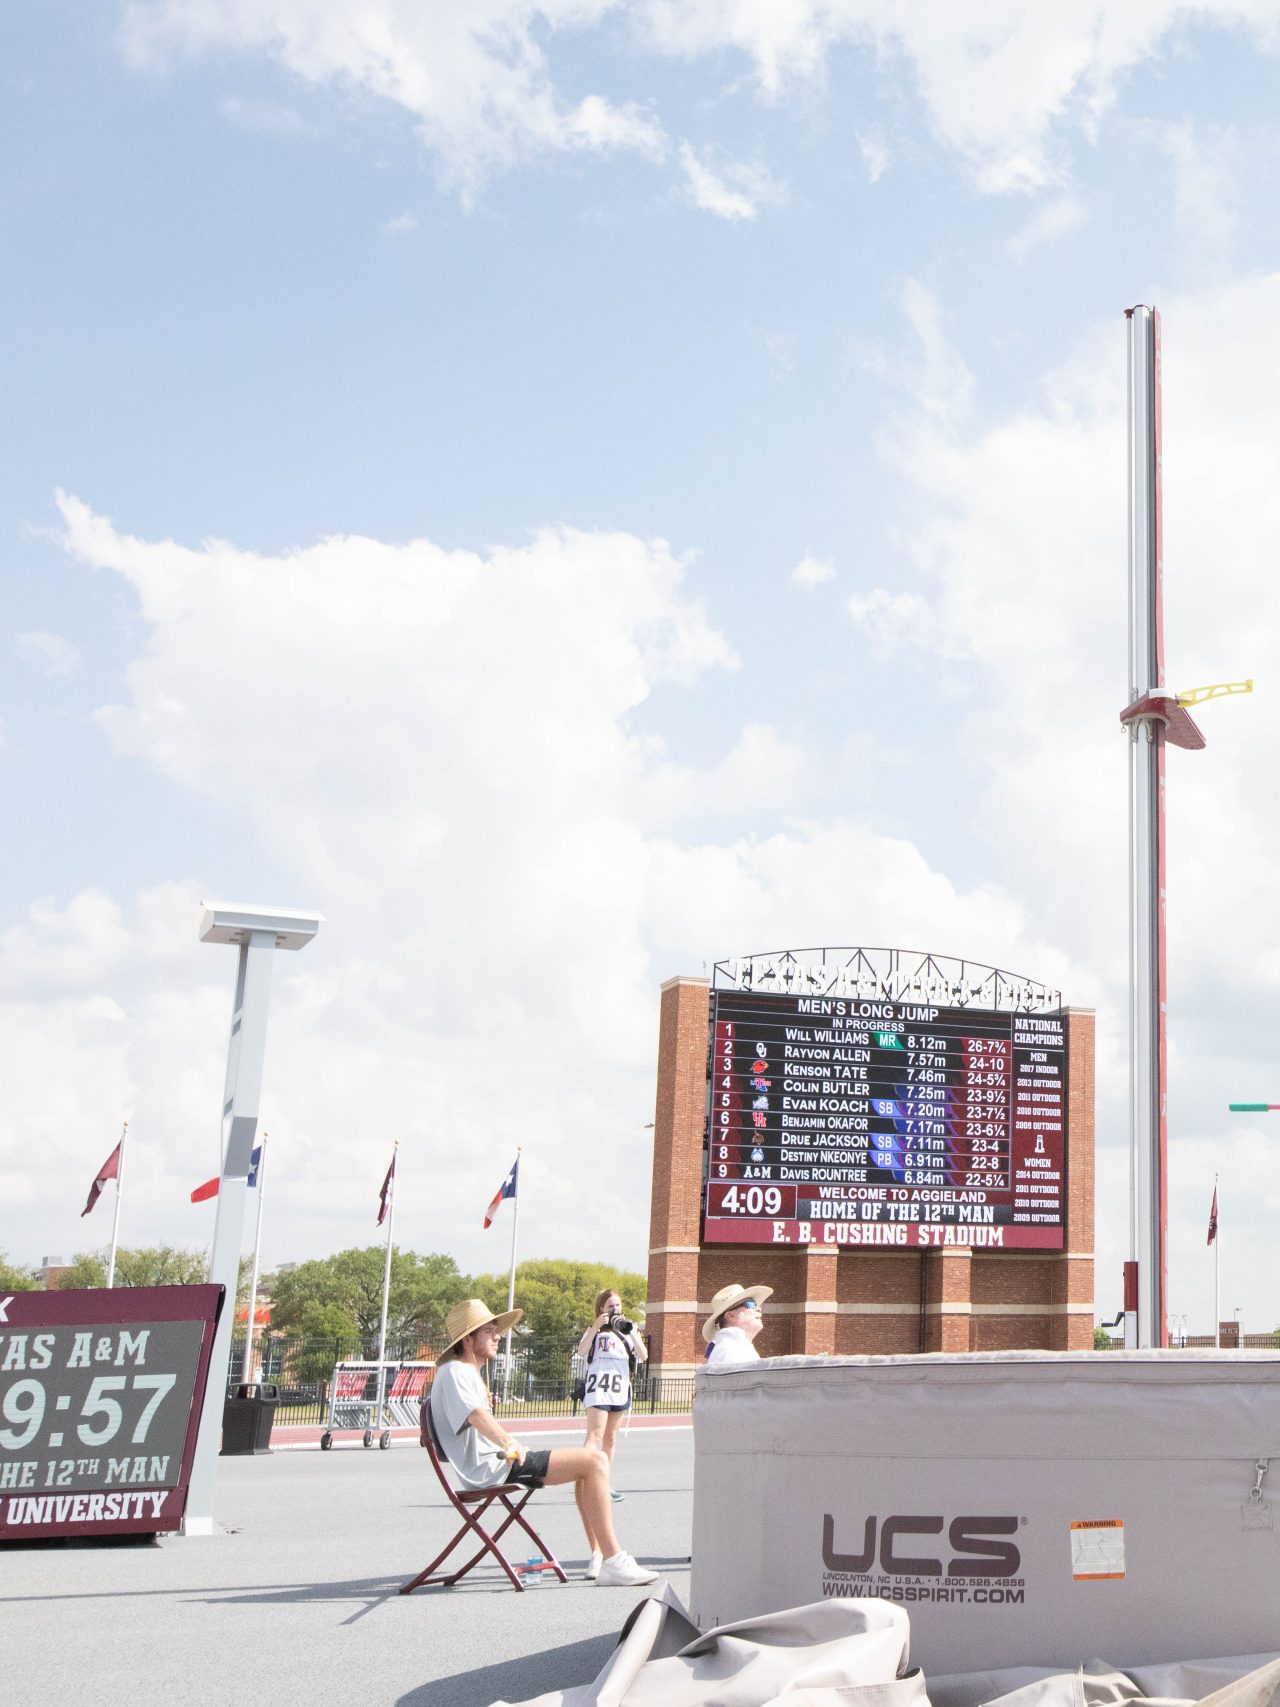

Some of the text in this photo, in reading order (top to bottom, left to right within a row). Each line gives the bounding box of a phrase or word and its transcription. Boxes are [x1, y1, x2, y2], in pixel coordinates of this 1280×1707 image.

[729, 957, 827, 994] TEXAS
[798, 999, 938, 1021] MEN'S LONG JUMP
[832, 1019, 904, 1032] IN PROGRESS
[1015, 1019, 1063, 1032] NATIONAL
[726, 1024, 732, 1036] 1
[786, 1028, 811, 1041] WILL
[814, 1030, 869, 1045] WILLIAMS
[879, 1033, 896, 1047] MR
[908, 1036, 946, 1050] 8.12m
[1015, 1033, 1063, 1045] CHAMPIONS
[724, 1042, 732, 1054] 2
[784, 1046, 830, 1059] RAYVON
[833, 1048, 870, 1062] ALLEN
[908, 1053, 946, 1066] 7.57m
[970, 1057, 1004, 1070] 24-10
[1031, 1053, 1047, 1062] MEN
[723, 1058, 732, 1071] 3
[784, 1064, 830, 1077] KENSON
[834, 1066, 867, 1079] TATE
[907, 1069, 945, 1082] 7.46m
[1036, 1066, 1058, 1074] INDOOR
[723, 1076, 730, 1088] 4
[783, 1080, 820, 1093] COLIN
[823, 1082, 869, 1095] BUTLER
[907, 1086, 945, 1099] 7.25m
[1017, 1078, 1061, 1088] 2013 OUTDOOR
[722, 1094, 730, 1106] 5
[783, 1097, 817, 1110] EVAN
[820, 1099, 868, 1112] KOACH
[879, 1102, 893, 1114] SB
[907, 1103, 944, 1117] 7.20m
[1018, 1093, 1060, 1102] 2011 OUTDOOR
[1017, 1107, 1061, 1116] 2010 OUTDOOR
[721, 1112, 729, 1125] 6
[782, 1115, 825, 1128] BENJAMIN
[827, 1117, 868, 1130] OKAFOR
[906, 1120, 944, 1134] 7.17m
[1033, 1122, 1061, 1131] OUTDOOR
[721, 1129, 999, 1153] 7 DRUE JACKSON SB 7.11m 23-4
[720, 1147, 998, 1169] 8 DESTINY NKEONYE PB 6.91m 22-8
[1024, 1158, 1051, 1167] WOMEN
[719, 1165, 727, 1177] 9
[744, 1166, 771, 1179] A&M
[781, 1167, 810, 1180] DAVIS
[812, 1168, 867, 1181] ROUNTREE
[905, 1171, 943, 1185] 6.84m
[819, 1187, 986, 1203] WELCOME TO AGGIELAND
[1030, 1185, 1059, 1193] OUTDOOR
[721, 1186, 782, 1214] 4:09
[1015, 1199, 1059, 1208] 2010 OUTDOOR
[810, 1202, 994, 1223] HOME OF THE 12TH MAN
[1032, 1214, 1060, 1222] OUTDOOR
[773, 1222, 1004, 1246] E. B. CUSHING STADIUM
[0, 1330, 150, 1371] AS A&M
[587, 1374, 622, 1393] 246
[0, 1456, 169, 1489] HE 12TH MAN
[7, 1492, 168, 1525] UNIVERSITY
[822, 1513, 1021, 1577] UCS
[823, 1572, 874, 1584] LINCOLNTON,
[878, 1576, 890, 1584] NC
[895, 1577, 924, 1585] U.S.A.
[822, 1582, 1025, 1603] WWW.UCSSPIRIT.COM
